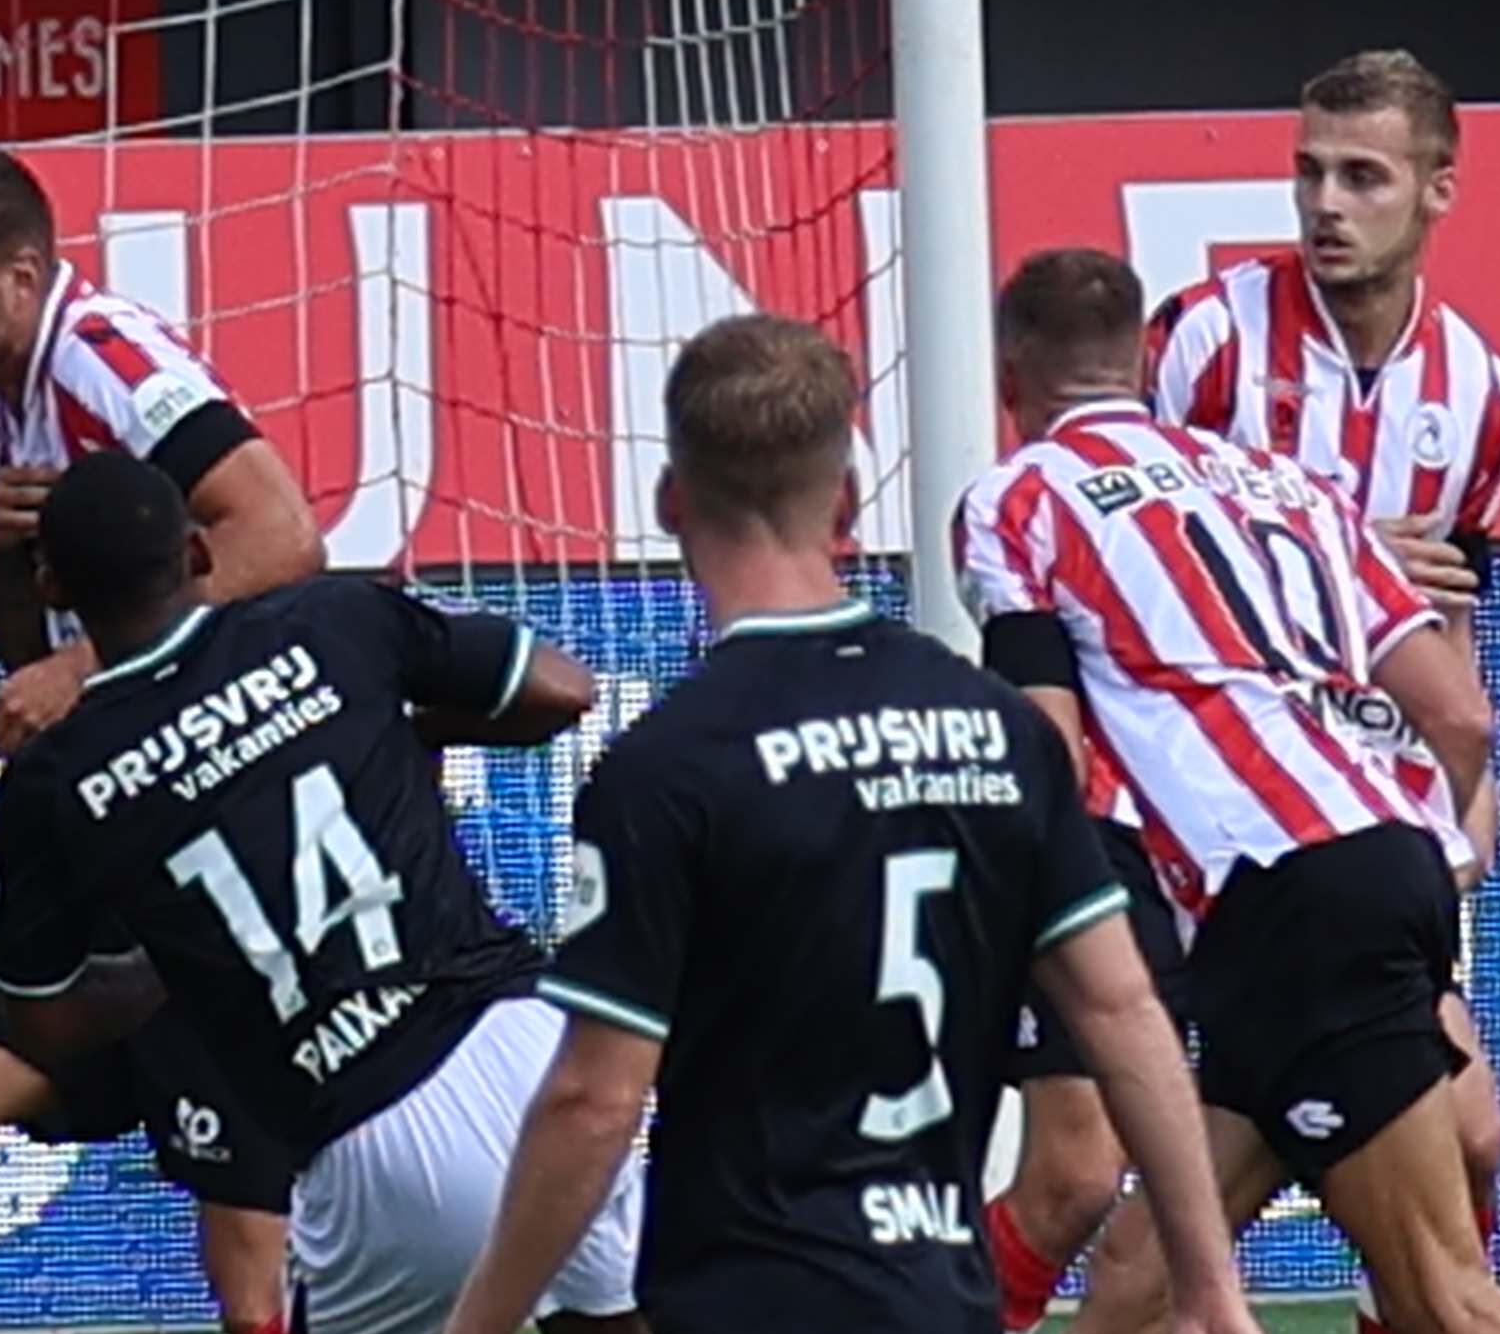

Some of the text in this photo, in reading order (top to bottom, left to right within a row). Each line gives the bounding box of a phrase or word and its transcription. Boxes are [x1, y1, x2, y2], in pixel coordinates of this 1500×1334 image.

[172, 685, 344, 805] vakanties
[855, 766, 1022, 813] vakanties
[166, 762, 404, 1026] 14
[291, 983, 428, 1085] PAIXA
[859, 848, 960, 1141] 5
